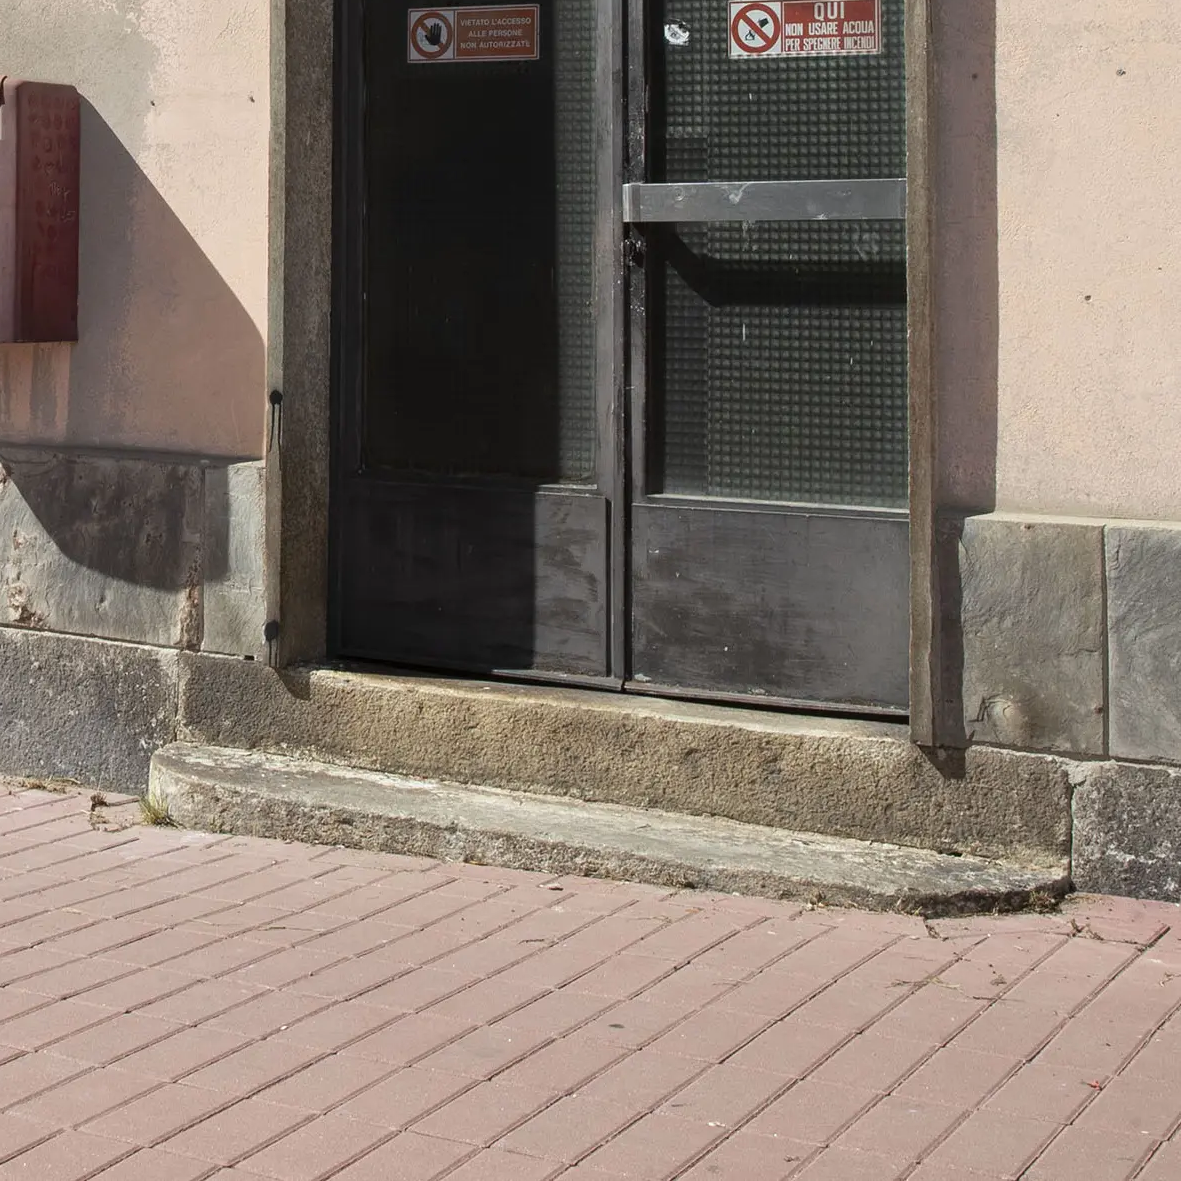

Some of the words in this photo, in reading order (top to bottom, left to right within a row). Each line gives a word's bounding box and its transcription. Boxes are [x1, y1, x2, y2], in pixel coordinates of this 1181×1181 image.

[814, 1, 845, 21] QUI
[460, 18, 490, 28] VIETATO
[491, 17, 532, 27] L'ACCESSO
[785, 22, 804, 36] NON
[808, 21, 839, 36] USARE
[842, 19, 875, 35] ACQUA
[468, 29, 487, 39] ALLE
[488, 28, 523, 38] PERSONE
[460, 41, 477, 50] NON
[479, 39, 531, 49] AUTORIZZATE
[785, 37, 801, 52] PER
[803, 36, 841, 51] SPEGNERE
[843, 35, 875, 50] INCENDI
